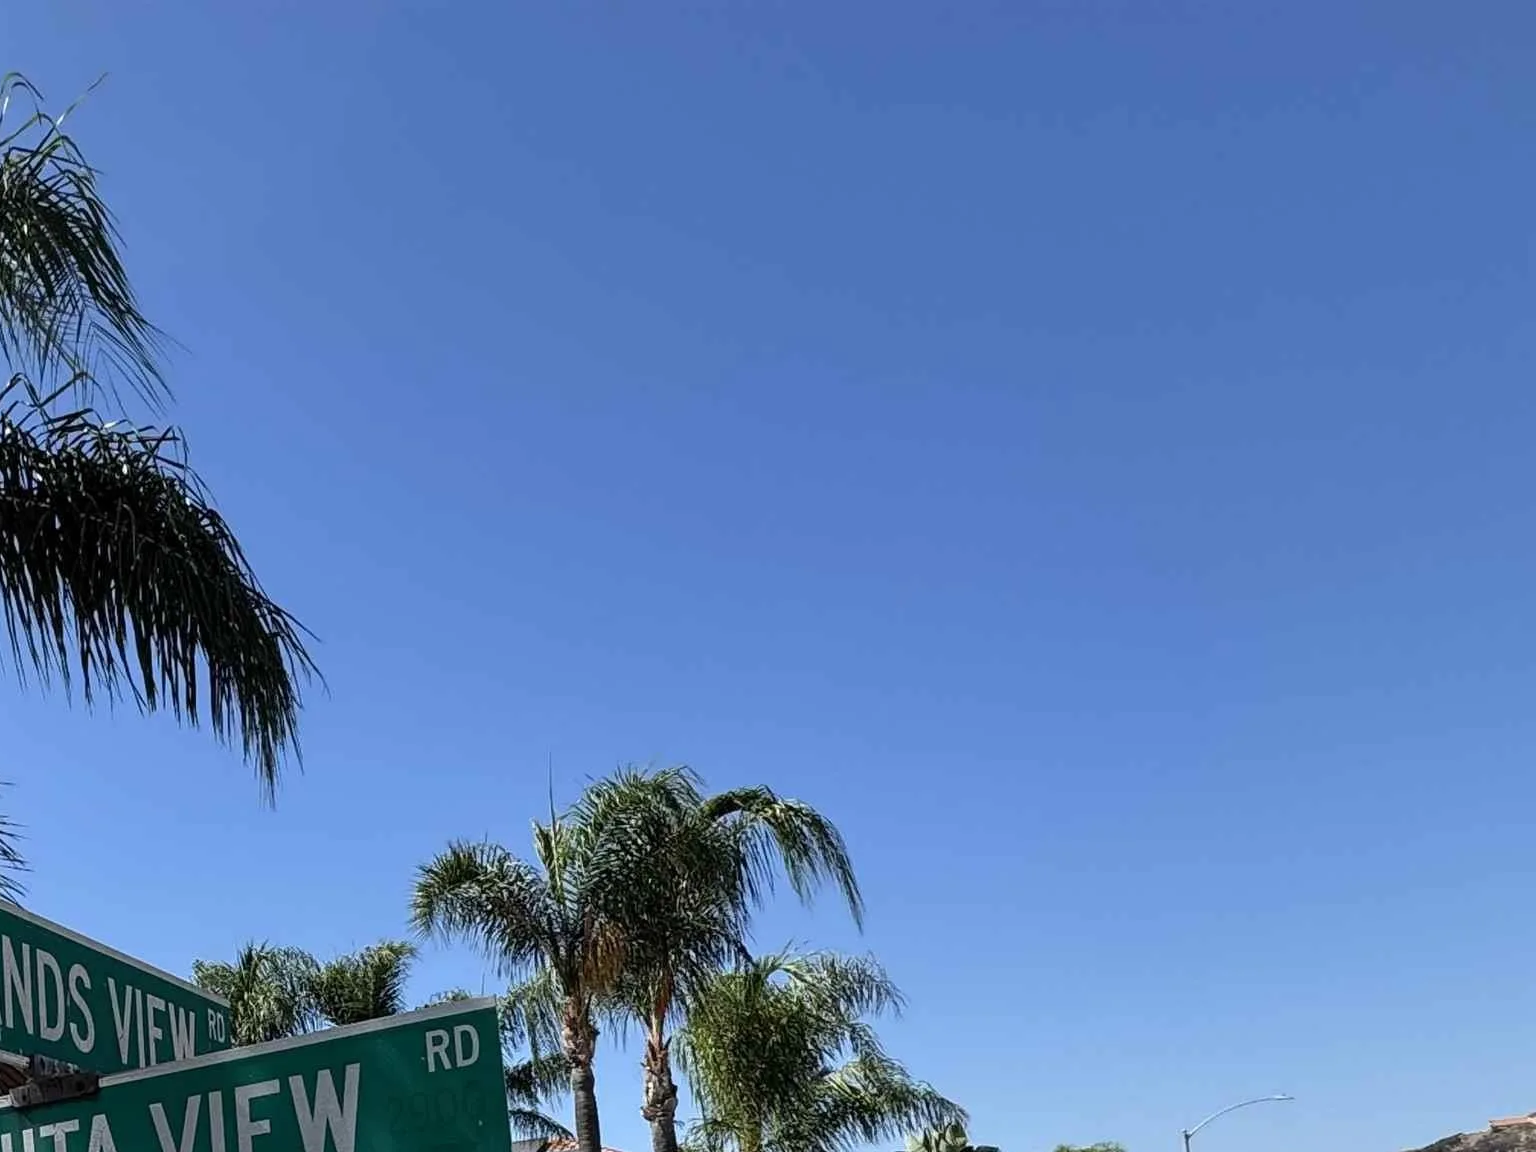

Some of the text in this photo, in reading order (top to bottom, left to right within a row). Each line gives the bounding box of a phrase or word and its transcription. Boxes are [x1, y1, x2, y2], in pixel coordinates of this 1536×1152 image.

[108, 976, 196, 1069] VIEW
[207, 1007, 225, 1044] RD
[425, 1024, 480, 1073] RD
